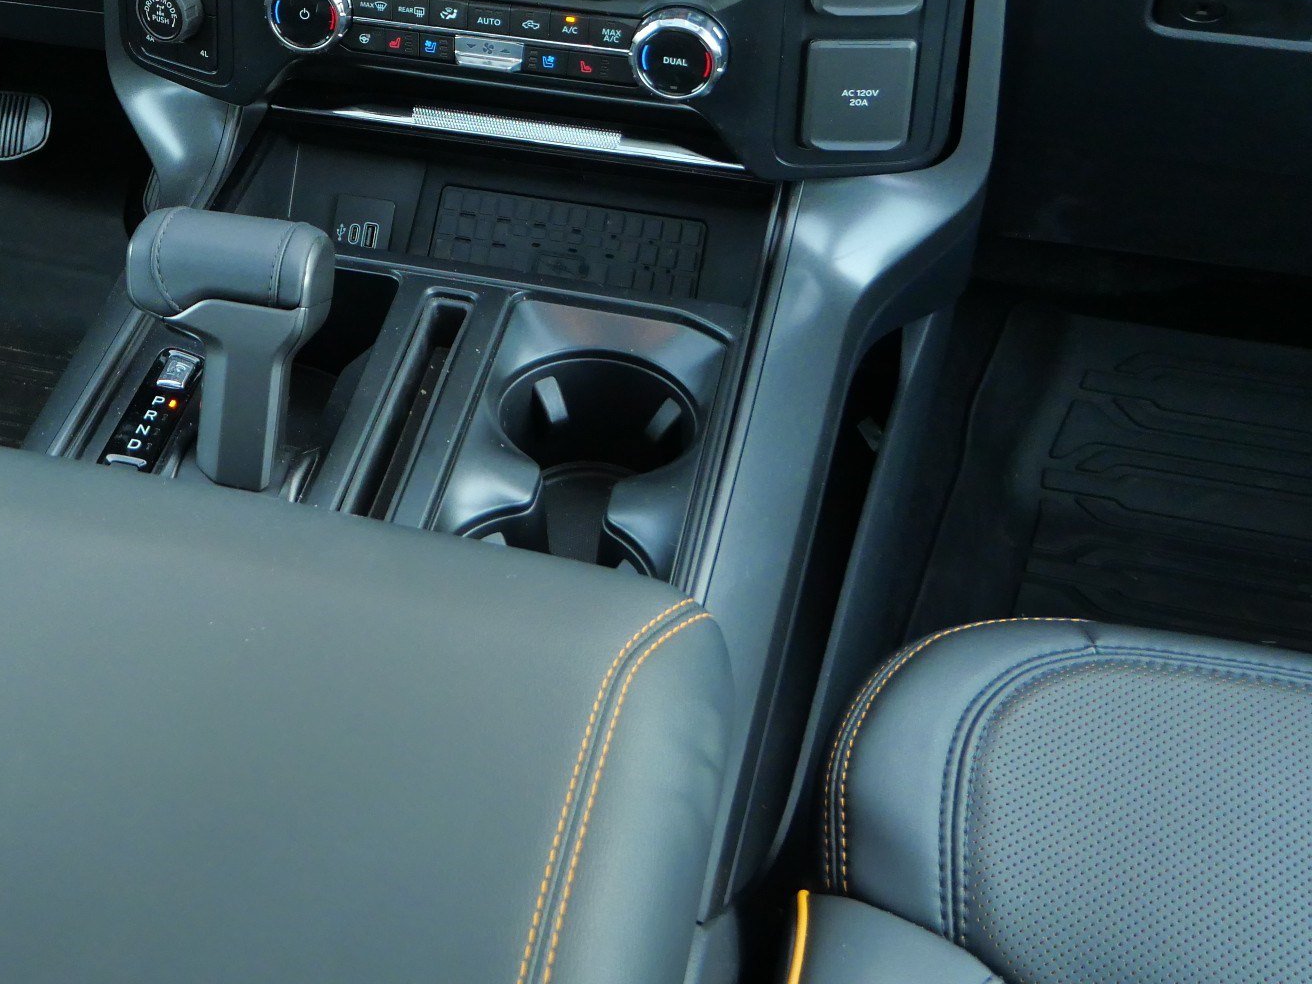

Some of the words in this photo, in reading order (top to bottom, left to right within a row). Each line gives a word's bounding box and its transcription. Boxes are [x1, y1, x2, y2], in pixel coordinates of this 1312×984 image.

[359, 0, 375, 9] MAX
[397, 5, 414, 15] REAR
[152, 14, 170, 25] PUSH
[477, 17, 501, 26] AUTO
[561, 25, 578, 35] A/C
[601, 27, 622, 37] MAX
[602, 34, 621, 44] A/C
[200, 49, 209, 58] 4L
[662, 56, 688, 66] DUAL
[841, 89, 856, 97] AC
[856, 89, 879, 97] 120V
[849, 98, 868, 106] 20A
[151, 395, 166, 405] P
[143, 409, 158, 421] R
[135, 424, 151, 436] N
[127, 438, 142, 449] D
